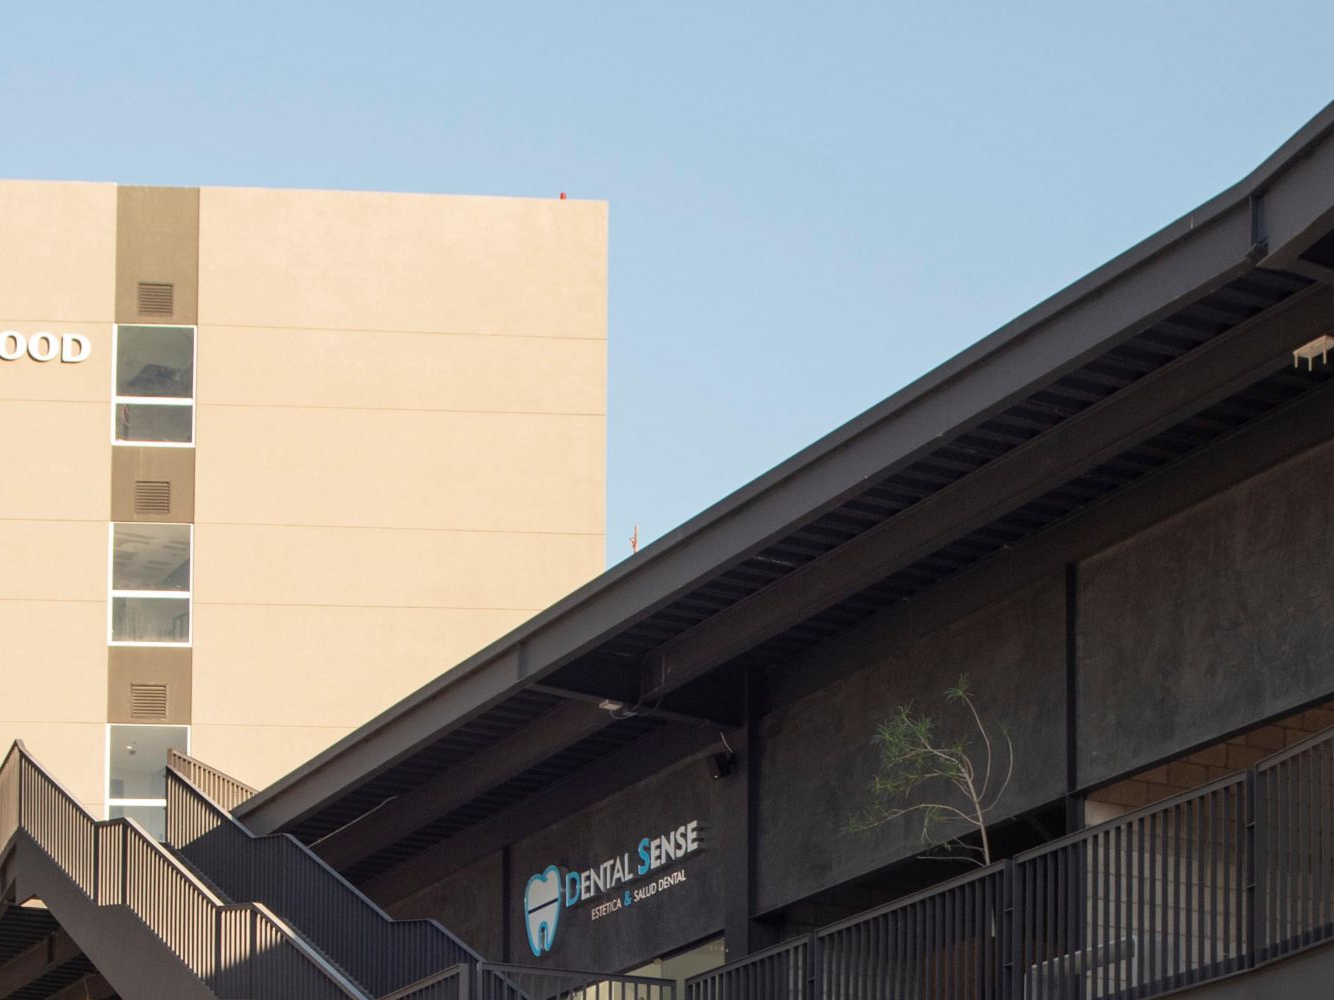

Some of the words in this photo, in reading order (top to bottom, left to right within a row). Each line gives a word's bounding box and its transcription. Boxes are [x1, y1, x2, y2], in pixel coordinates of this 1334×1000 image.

[566, 853, 633, 908] DENTAL
[638, 820, 698, 876] SENSE
[624, 890, 632, 907] &
[634, 882, 657, 902] SALUD
[658, 869, 686, 891] DENTAL
